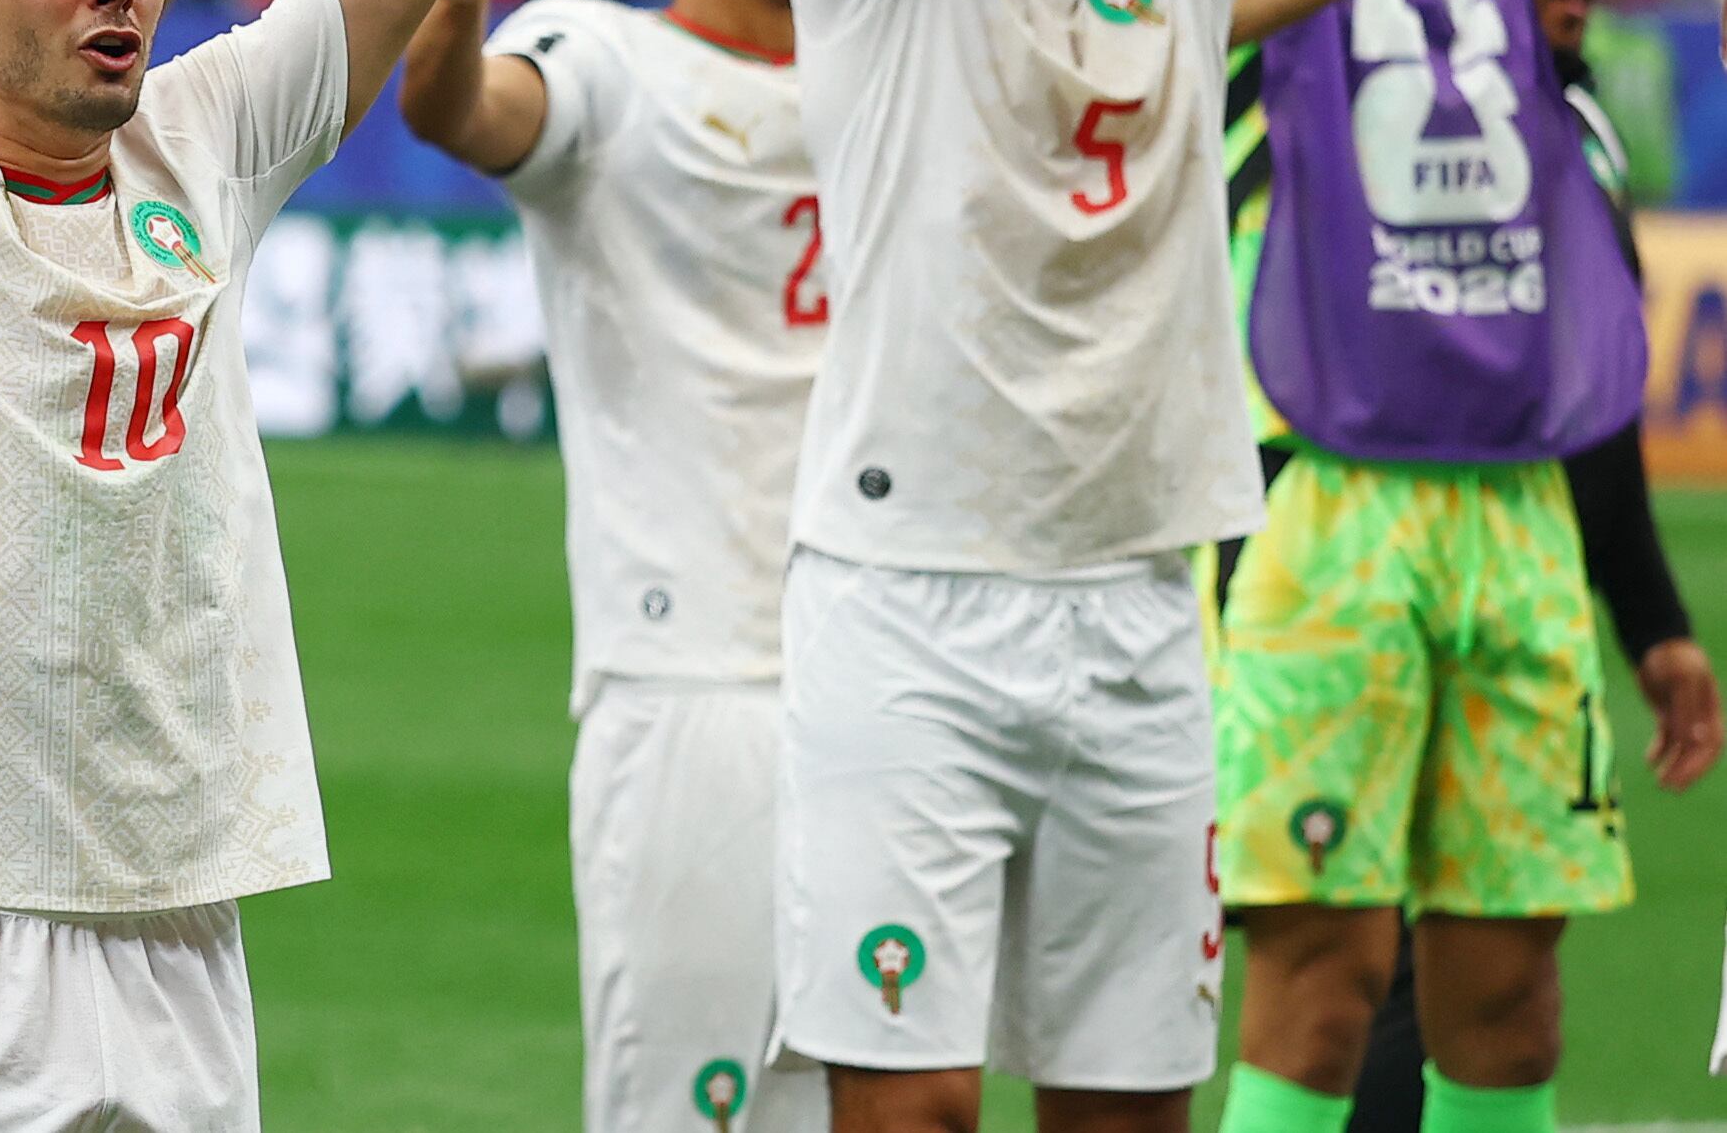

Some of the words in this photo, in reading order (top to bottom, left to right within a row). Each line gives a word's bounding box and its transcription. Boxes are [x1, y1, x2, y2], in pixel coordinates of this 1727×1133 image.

[1072, 97, 1145, 215] 5
[1413, 158, 1497, 190] FIFA
[1368, 261, 1548, 316] 2026
[70, 317, 194, 471] 10
